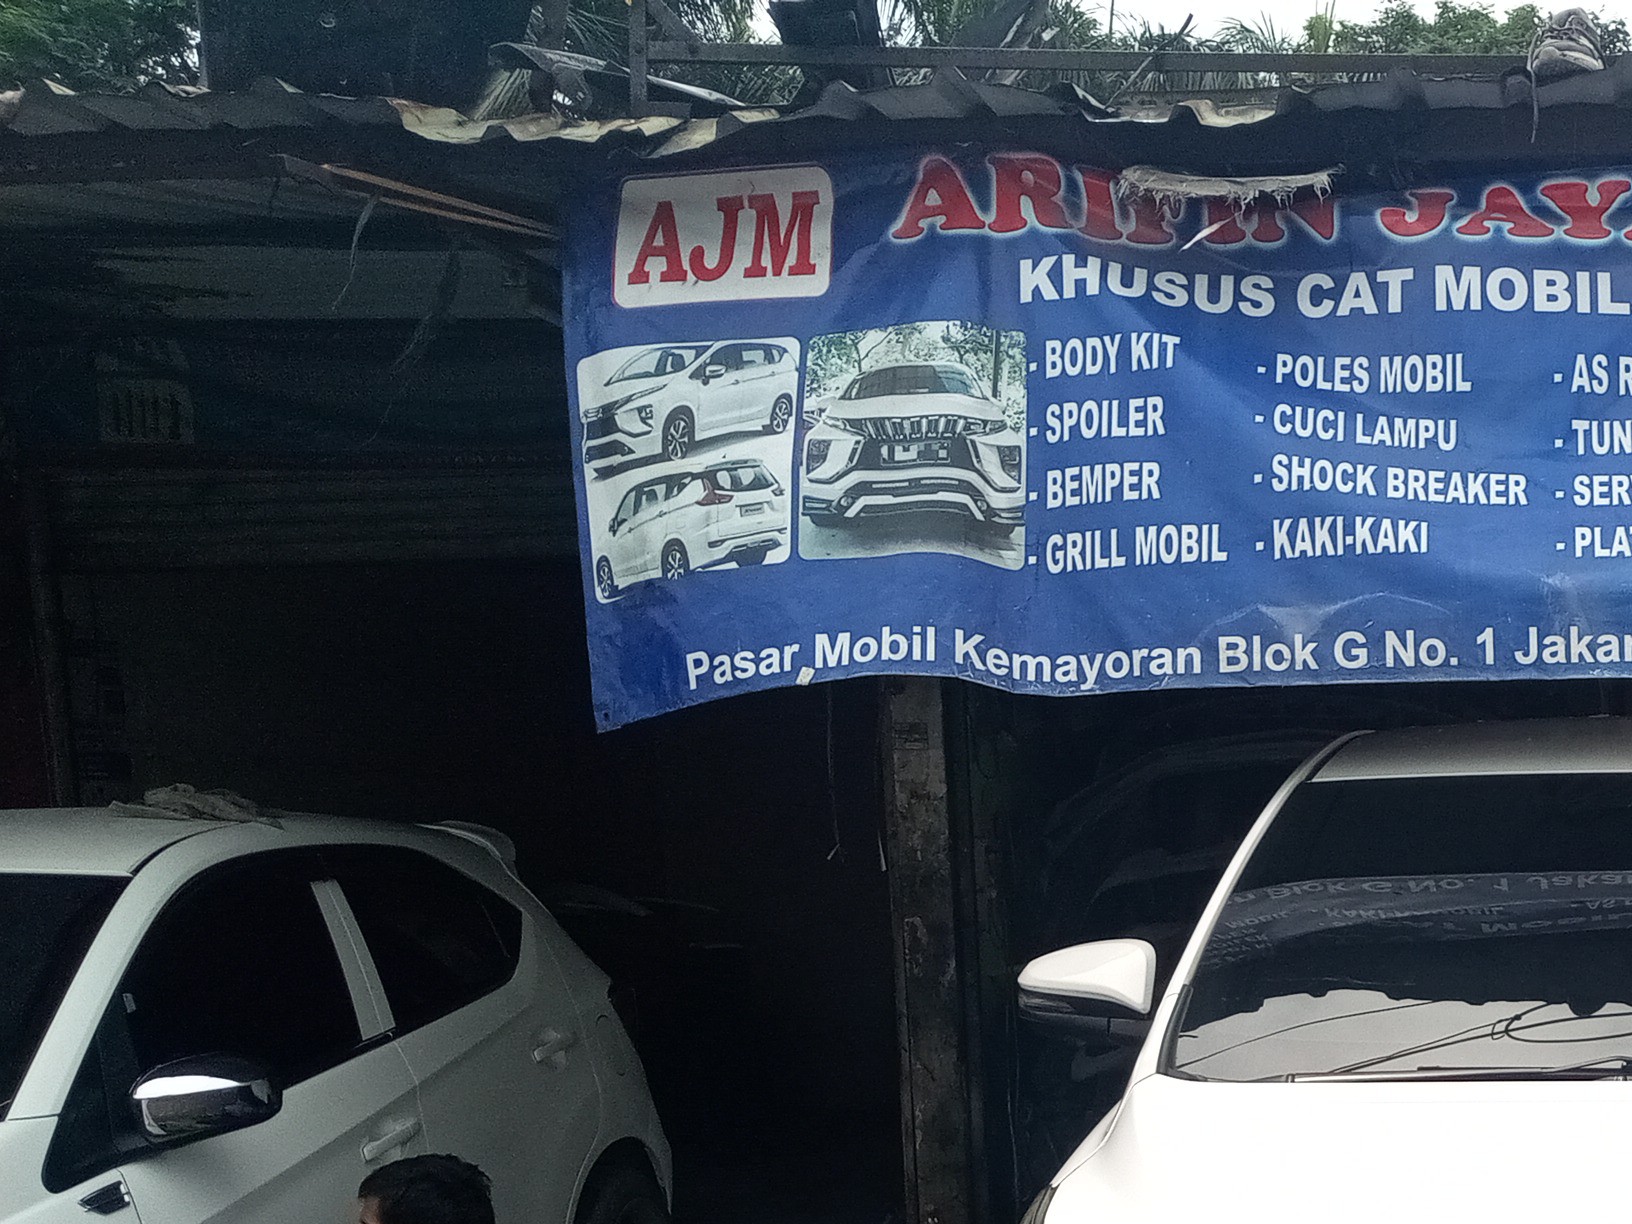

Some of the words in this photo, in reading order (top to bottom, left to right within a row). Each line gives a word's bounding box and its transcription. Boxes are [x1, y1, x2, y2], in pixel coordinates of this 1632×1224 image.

[890, 154, 1338, 247] ARIFIN
[627, 189, 820, 285] AJM
[1018, 253, 1276, 317] KHUSUS
[1296, 267, 1414, 318] CAT
[1434, 264, 1631, 316] MOBIL
[1045, 333, 1123, 379] BODY
[1130, 332, 1181, 371] KIT
[1274, 352, 1371, 394] POLES
[1379, 352, 1473, 394] MOBIL
[1570, 353, 1609, 395] AS
[1045, 395, 1166, 444] SPOILER
[1272, 403, 1346, 442] CUCI
[1355, 413, 1459, 452] LAMPU
[1045, 461, 1162, 510] BEMPER
[1270, 453, 1378, 496] SHOCK
[1386, 466, 1530, 507] BREAKER
[1045, 528, 1127, 574] GRILL
[1134, 523, 1229, 566] MOBIL
[1271, 515, 1430, 561] KAKI-KAKI
[813, 625, 937, 671] Mobil
[953, 627, 1203, 694] Kemayoran
[1217, 633, 1321, 676] Blok
[1333, 630, 1369, 671] G
[1384, 629, 1459, 669] No.
[1476, 626, 1497, 666] 1
